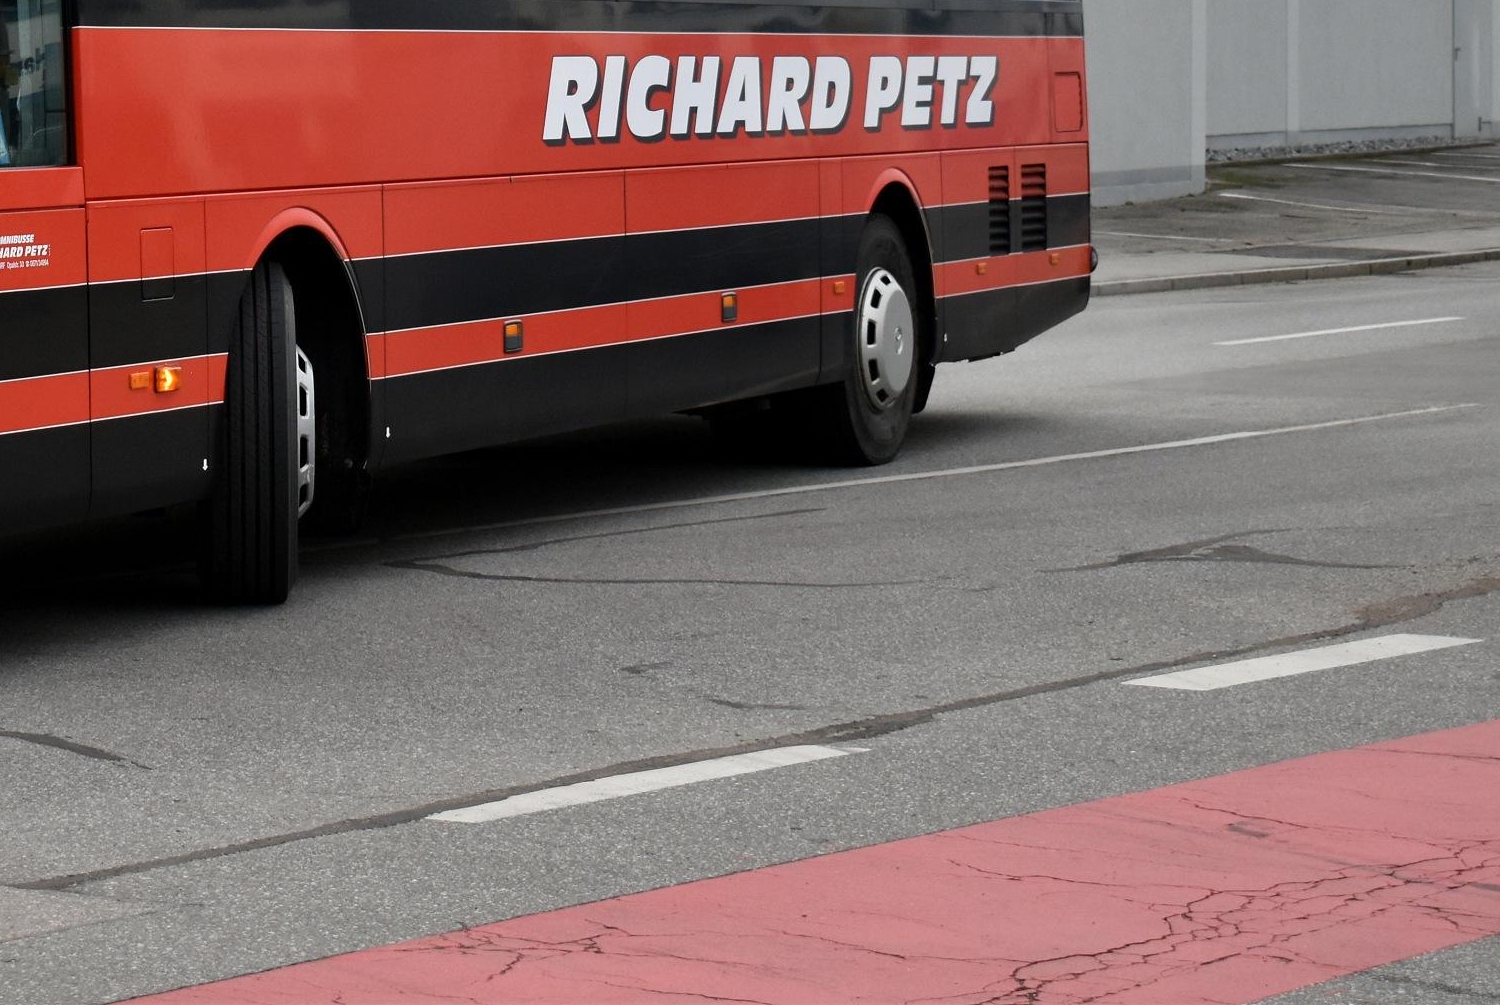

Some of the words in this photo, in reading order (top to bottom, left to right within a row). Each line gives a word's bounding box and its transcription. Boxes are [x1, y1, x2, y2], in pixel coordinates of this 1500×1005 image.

[542, 55, 852, 143] RICHARD
[863, 56, 998, 130] PETZ
[24, 244, 48, 257] PETZ
